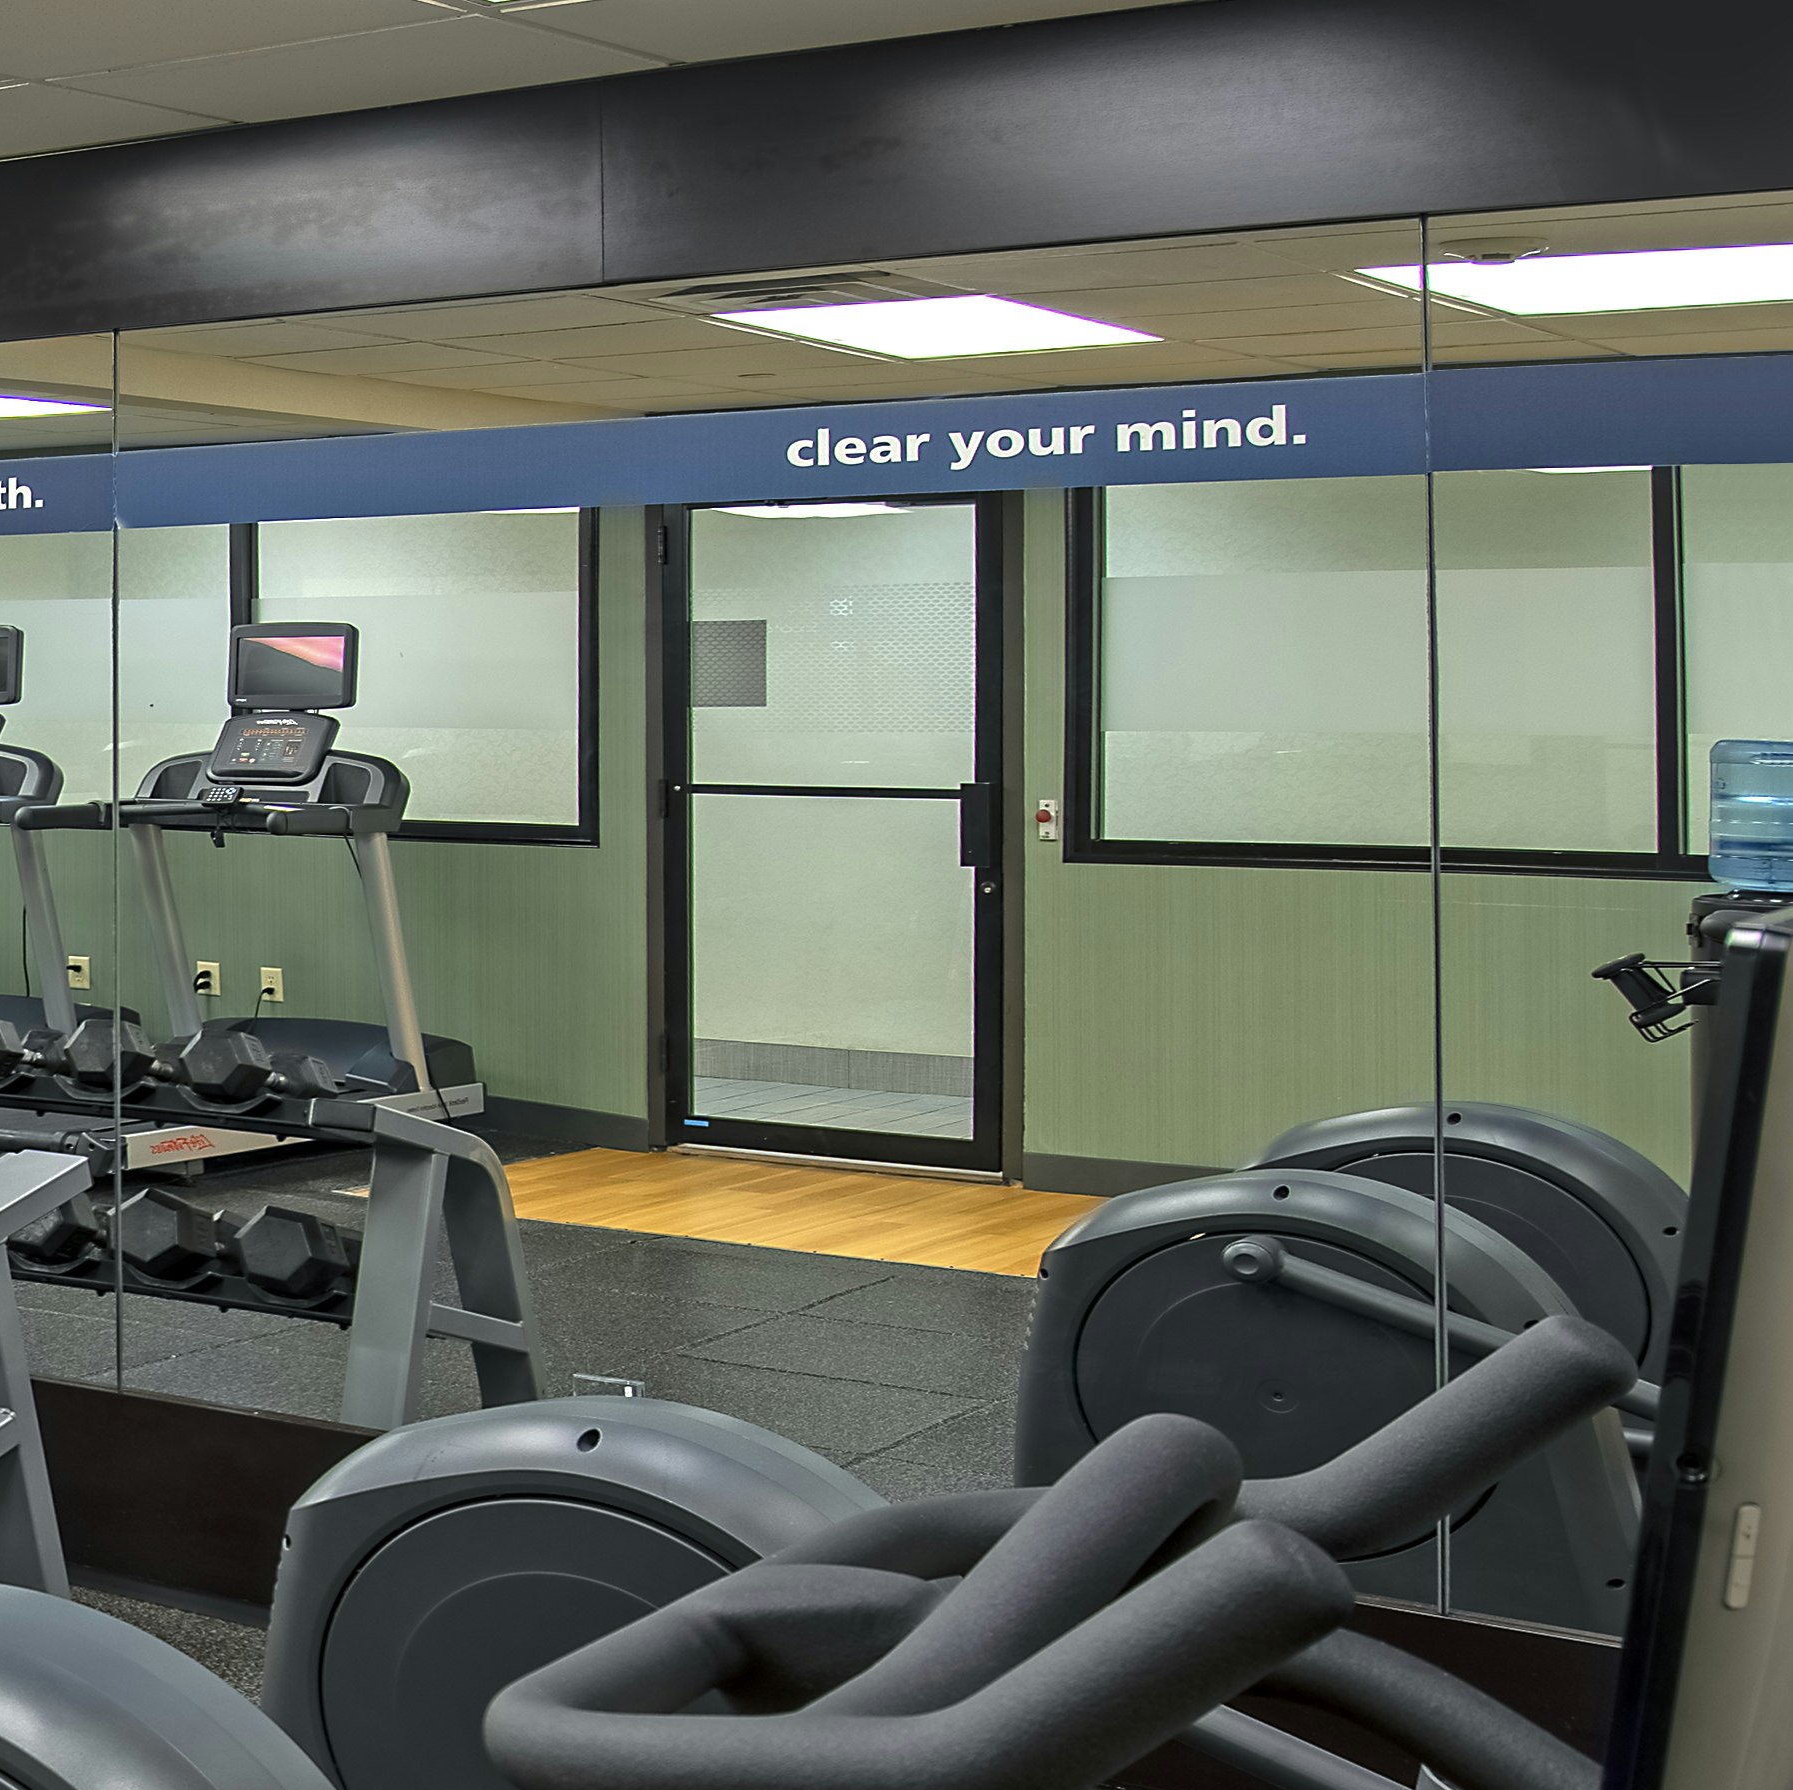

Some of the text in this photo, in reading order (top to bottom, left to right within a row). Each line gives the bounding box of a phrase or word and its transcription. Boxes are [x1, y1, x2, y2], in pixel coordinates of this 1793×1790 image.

[787, 404, 1308, 471] clear your mind.
